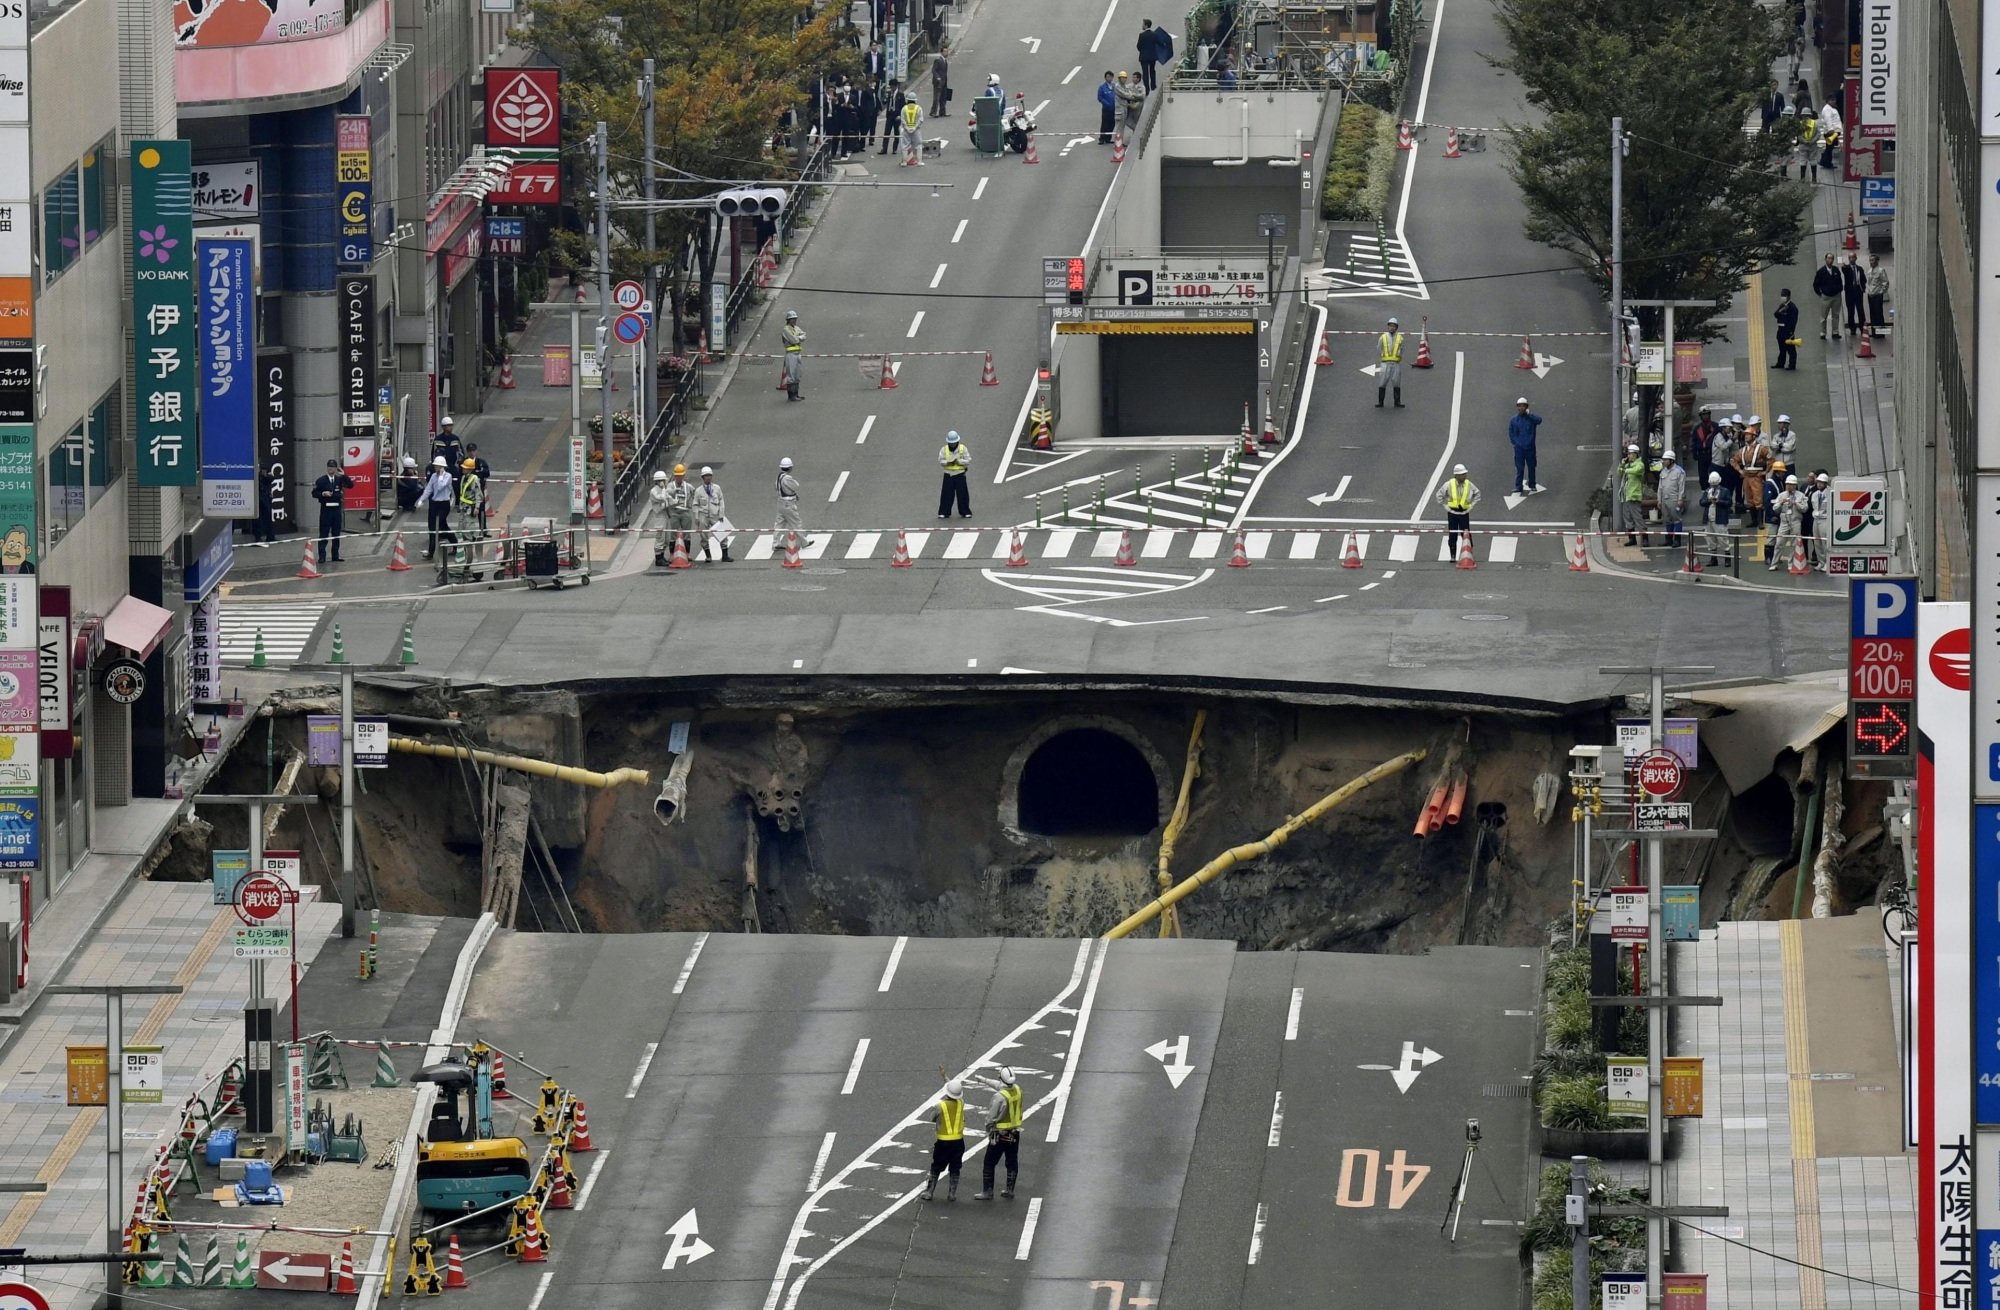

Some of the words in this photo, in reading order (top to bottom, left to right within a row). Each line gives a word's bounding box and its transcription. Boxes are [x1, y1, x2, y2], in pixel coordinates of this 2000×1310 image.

[1870, 5, 1891, 117] HanaTour
[340, 119, 368, 134] 24h
[340, 134, 368, 142] OPEN
[341, 168, 368, 182] 100円
[1303, 170, 1311, 189] 出口
[1866, 180, 1880, 197] P
[193, 188, 243, 208] ホルモン
[344, 244, 368, 260] 6F
[490, 239, 521, 253] ATM
[235, 247, 243, 291] Dramatic
[1044, 260, 1066, 272] 一般P
[137, 270, 157, 280] IYO
[158, 270, 189, 280] BANK
[1044, 276, 1067, 288] タクシー
[1156, 271, 1265, 282] 地下送迎場・駐車場
[620, 290, 637, 304] 40
[1123, 277, 1148, 305] P
[1052, 307, 1083, 318] 博多駅
[208, 247, 233, 397] アパマンショップ
[349, 299, 366, 345] CAFÉ
[1260, 320, 1269, 332] P
[350, 349, 359, 363] de
[1260, 348, 1269, 368] 入口
[146, 303, 183, 467] 伊予銀行
[351, 366, 367, 410] CRIÉ
[269, 367, 286, 432] CAFÉ
[354, 427, 364, 436] 1F
[270, 437, 284, 457] de
[215, 491, 242, 499] (0120)
[270, 462, 288, 523] CRIÉ
[1852, 559, 1865, 572] 酒
[1870, 559, 1888, 572] ATM
[1863, 582, 1908, 636] P
[1862, 641, 1904, 663] 20分
[1854, 664, 1912, 696] 100円
[21, 708, 33, 719] 3F
[1642, 768, 1676, 784] 消火栓
[1637, 805, 1689, 819] とみや歯科
[244, 890, 280, 908] 消火栓
[247, 929, 288, 938] むらつ歯科
[1335, 1148, 1432, 1210] 40
[1939, 1134, 1972, 1310] 太陽生命
